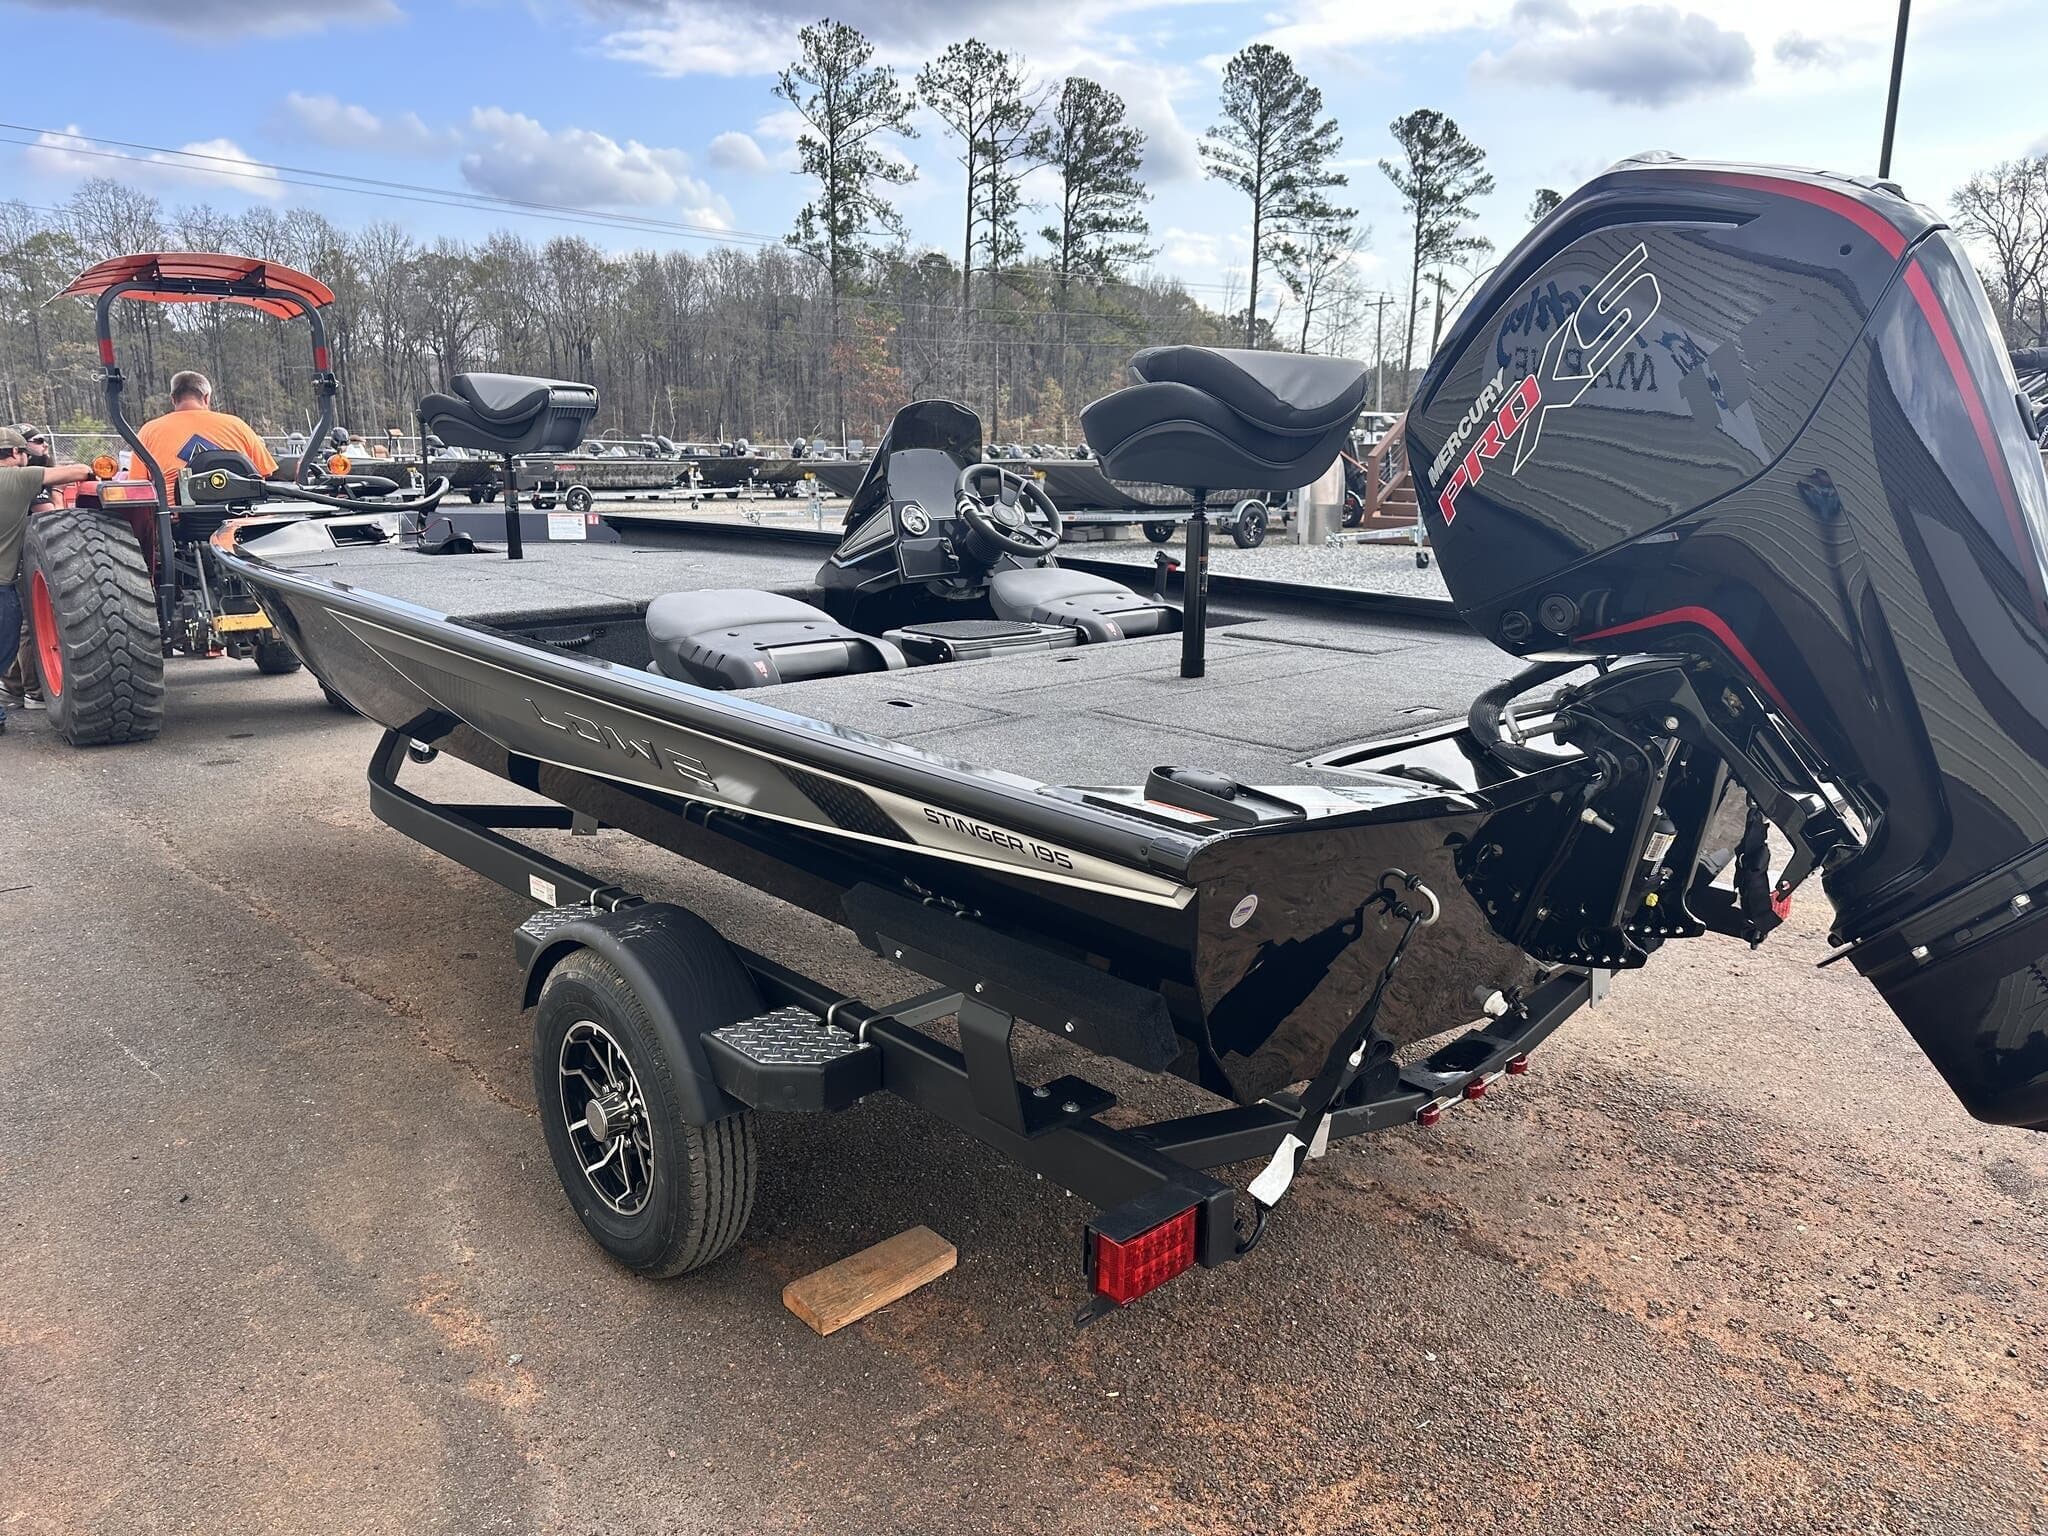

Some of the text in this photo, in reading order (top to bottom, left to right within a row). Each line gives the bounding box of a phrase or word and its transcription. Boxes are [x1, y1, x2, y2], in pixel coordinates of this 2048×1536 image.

[1427, 366, 1505, 488] MERCURY
[1438, 242, 1661, 527] PRO XS
[522, 697, 719, 792] LOWE
[923, 807, 1074, 870] STINGER 195
